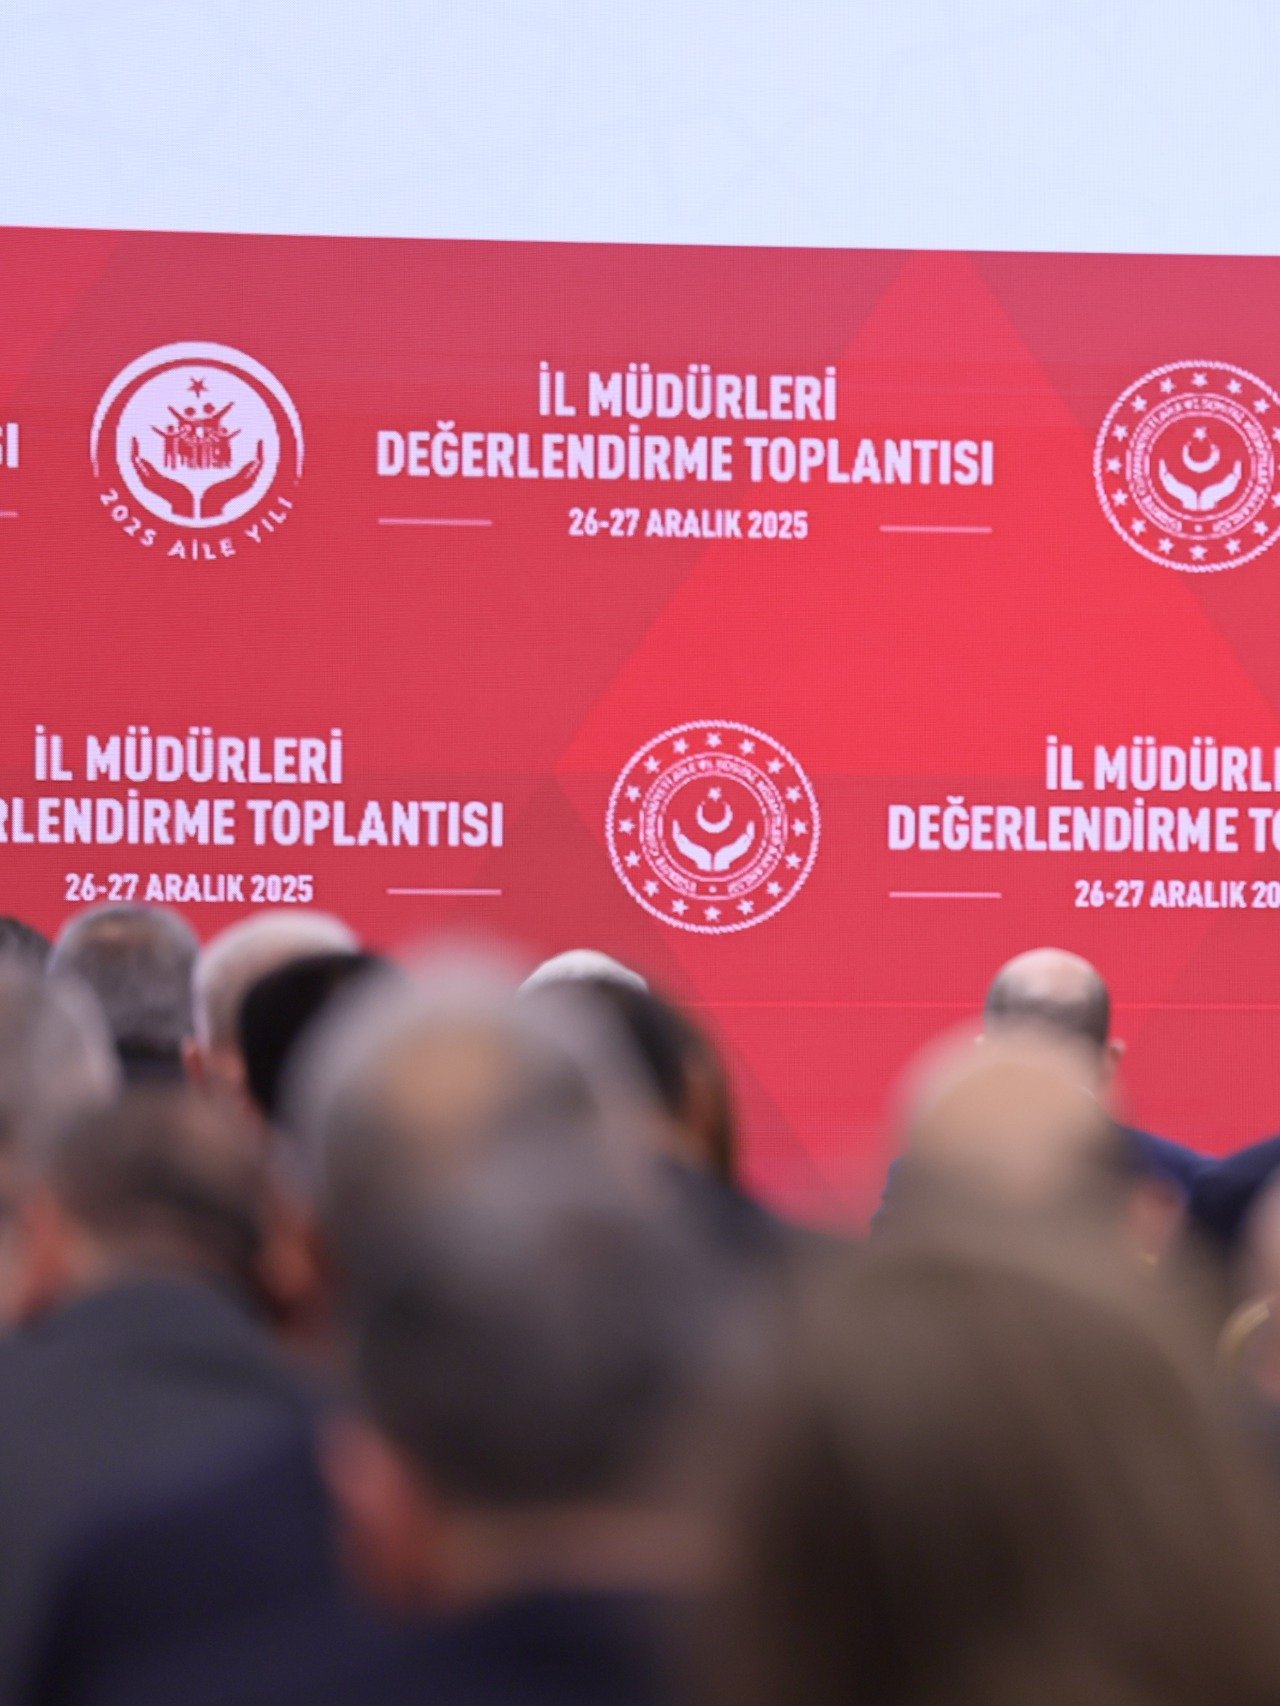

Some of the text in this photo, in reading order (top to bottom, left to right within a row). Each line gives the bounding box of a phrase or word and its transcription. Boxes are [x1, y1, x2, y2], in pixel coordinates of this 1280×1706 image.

[539, 360, 837, 421] İL MÜDÜRLERİ
[377, 420, 994, 486] DEĞERLENDİRME TOPLANTISI
[100, 487, 157, 546] 2025
[244, 496, 293, 543] YILI
[568, 507, 808, 539] 26-27 ARALIK 2025
[35, 724, 343, 784] İL MÜDÜRLERİ
[1046, 735, 1084, 791] İL
[246, 799, 504, 848] TOPLANTISI
[888, 795, 1238, 852] DEĞERLENDİRME
[65, 873, 313, 903] 26-27 ARALIK 2025
[1075, 879, 1145, 908] 26-27
[1150, 880, 1247, 909] ARALIK
